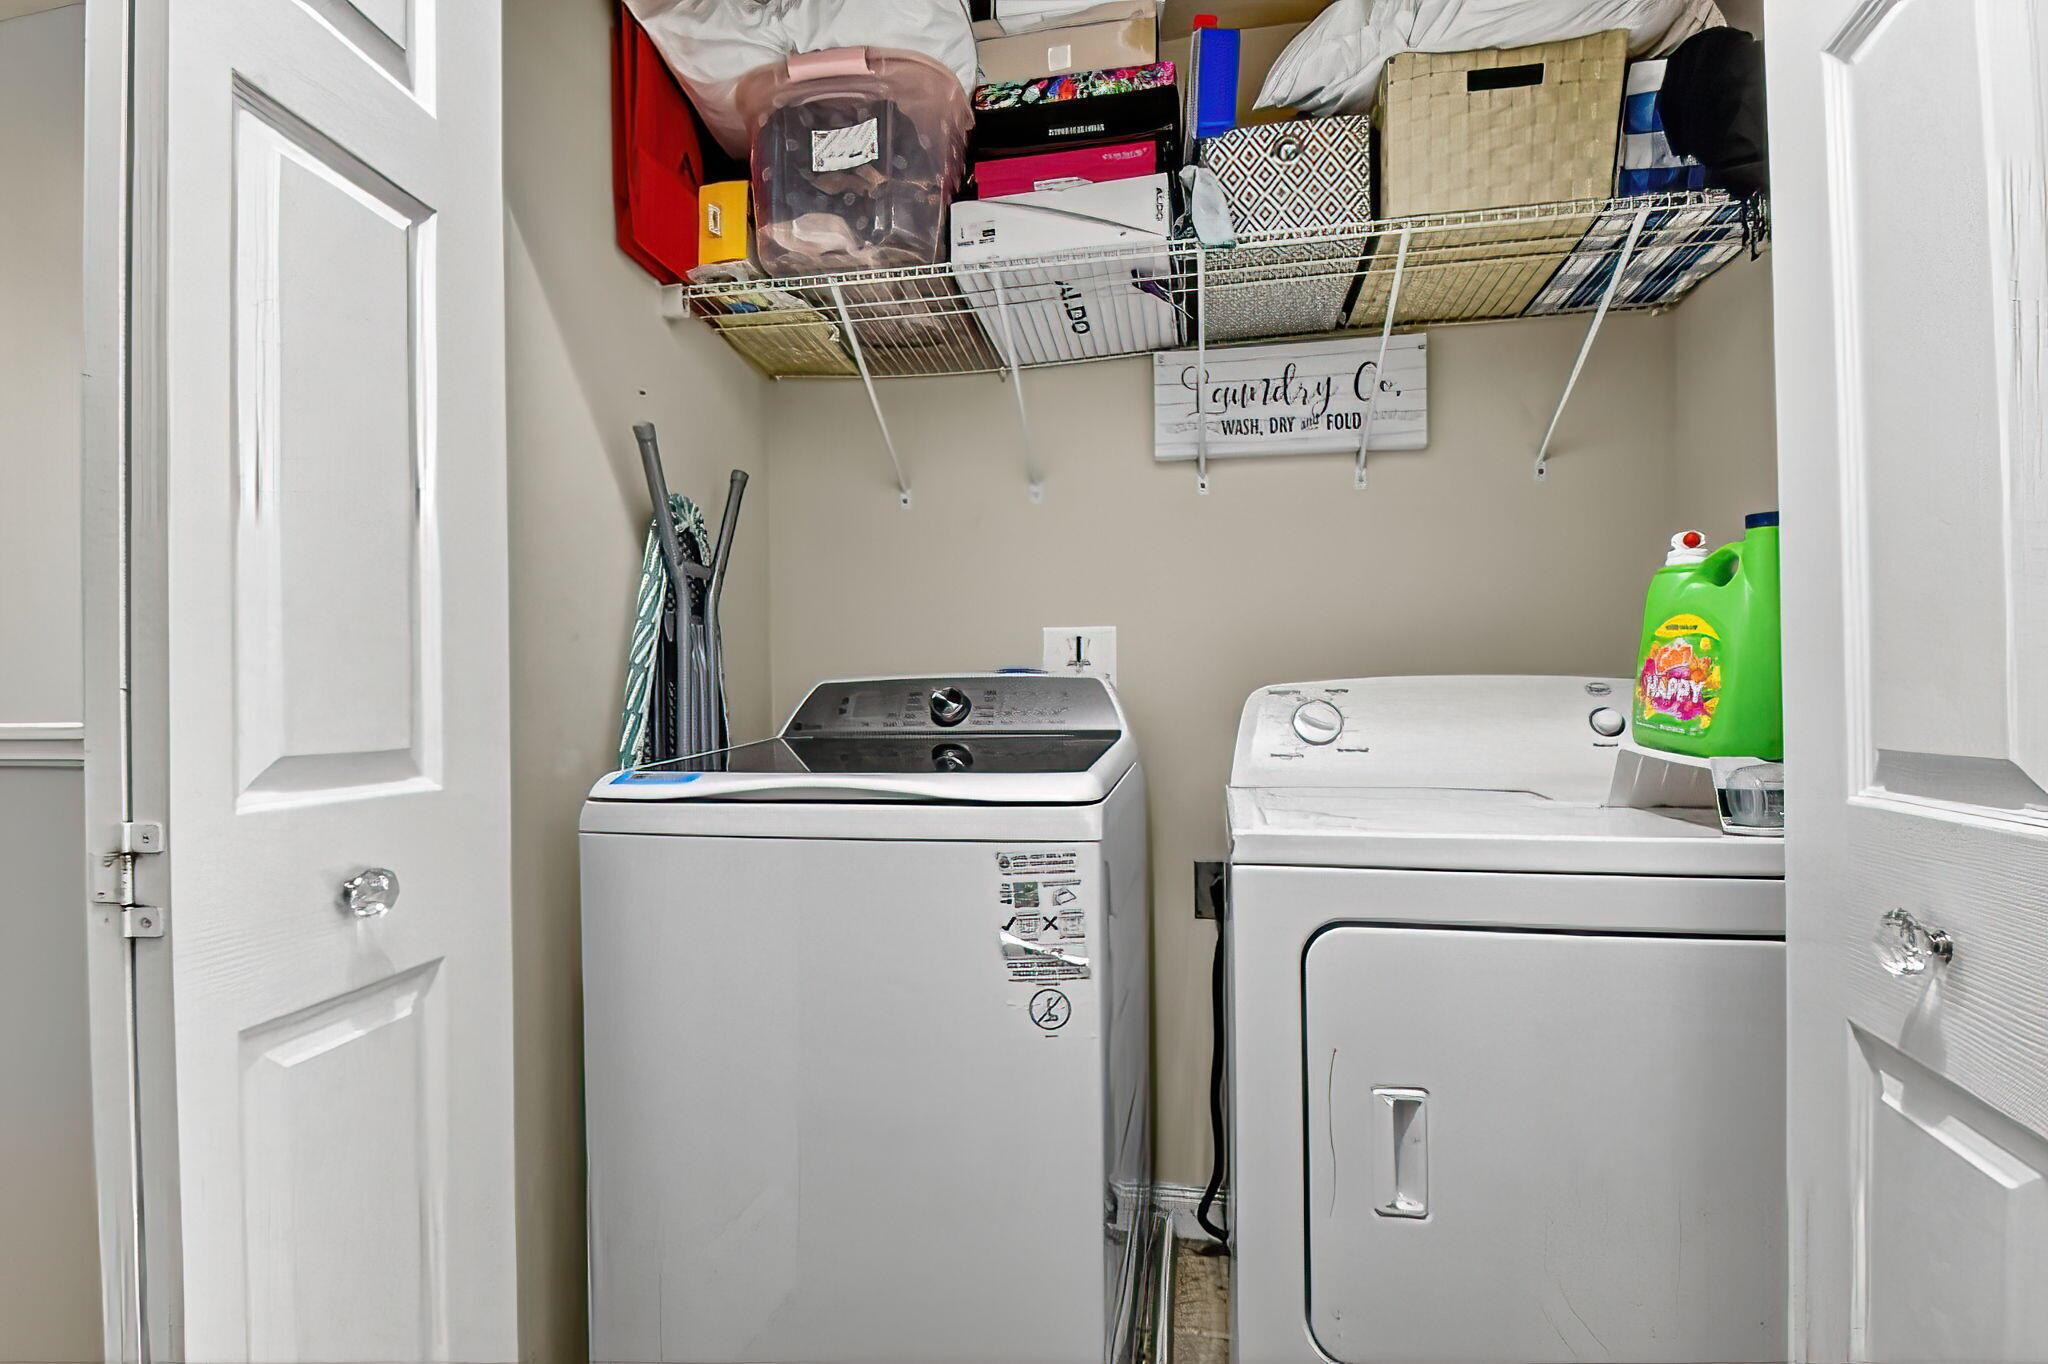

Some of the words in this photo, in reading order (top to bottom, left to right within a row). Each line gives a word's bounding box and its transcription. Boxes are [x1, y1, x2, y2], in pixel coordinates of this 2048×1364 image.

[1156, 187, 1164, 221] ALDO
[1181, 362, 1335, 417] Laundry
[1354, 360, 1402, 402] Co.
[1221, 417, 1264, 436] WASH,
[1269, 415, 1296, 434] DRY
[1326, 411, 1362, 430] FOLD
[1645, 675, 1706, 704] HAPPY
